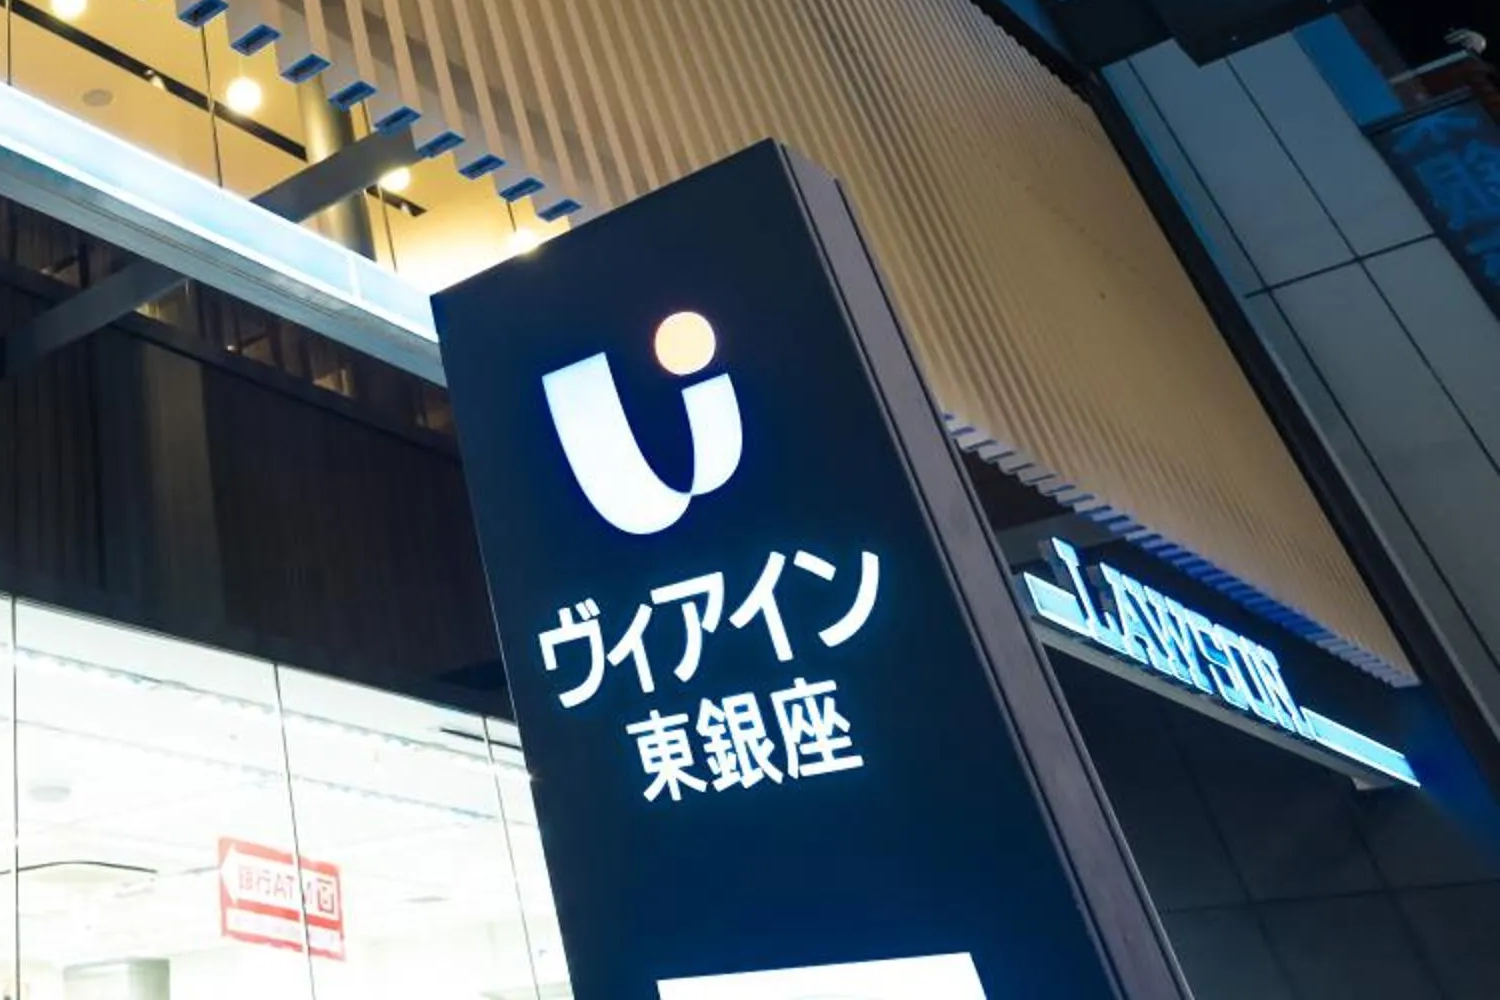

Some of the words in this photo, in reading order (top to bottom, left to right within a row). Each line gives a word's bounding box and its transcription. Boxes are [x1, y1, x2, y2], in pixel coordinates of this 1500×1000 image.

[538, 550, 881, 709] ヴィアイン
[1051, 536, 1318, 742] LAWSON
[626, 677, 864, 802] 東銀座
